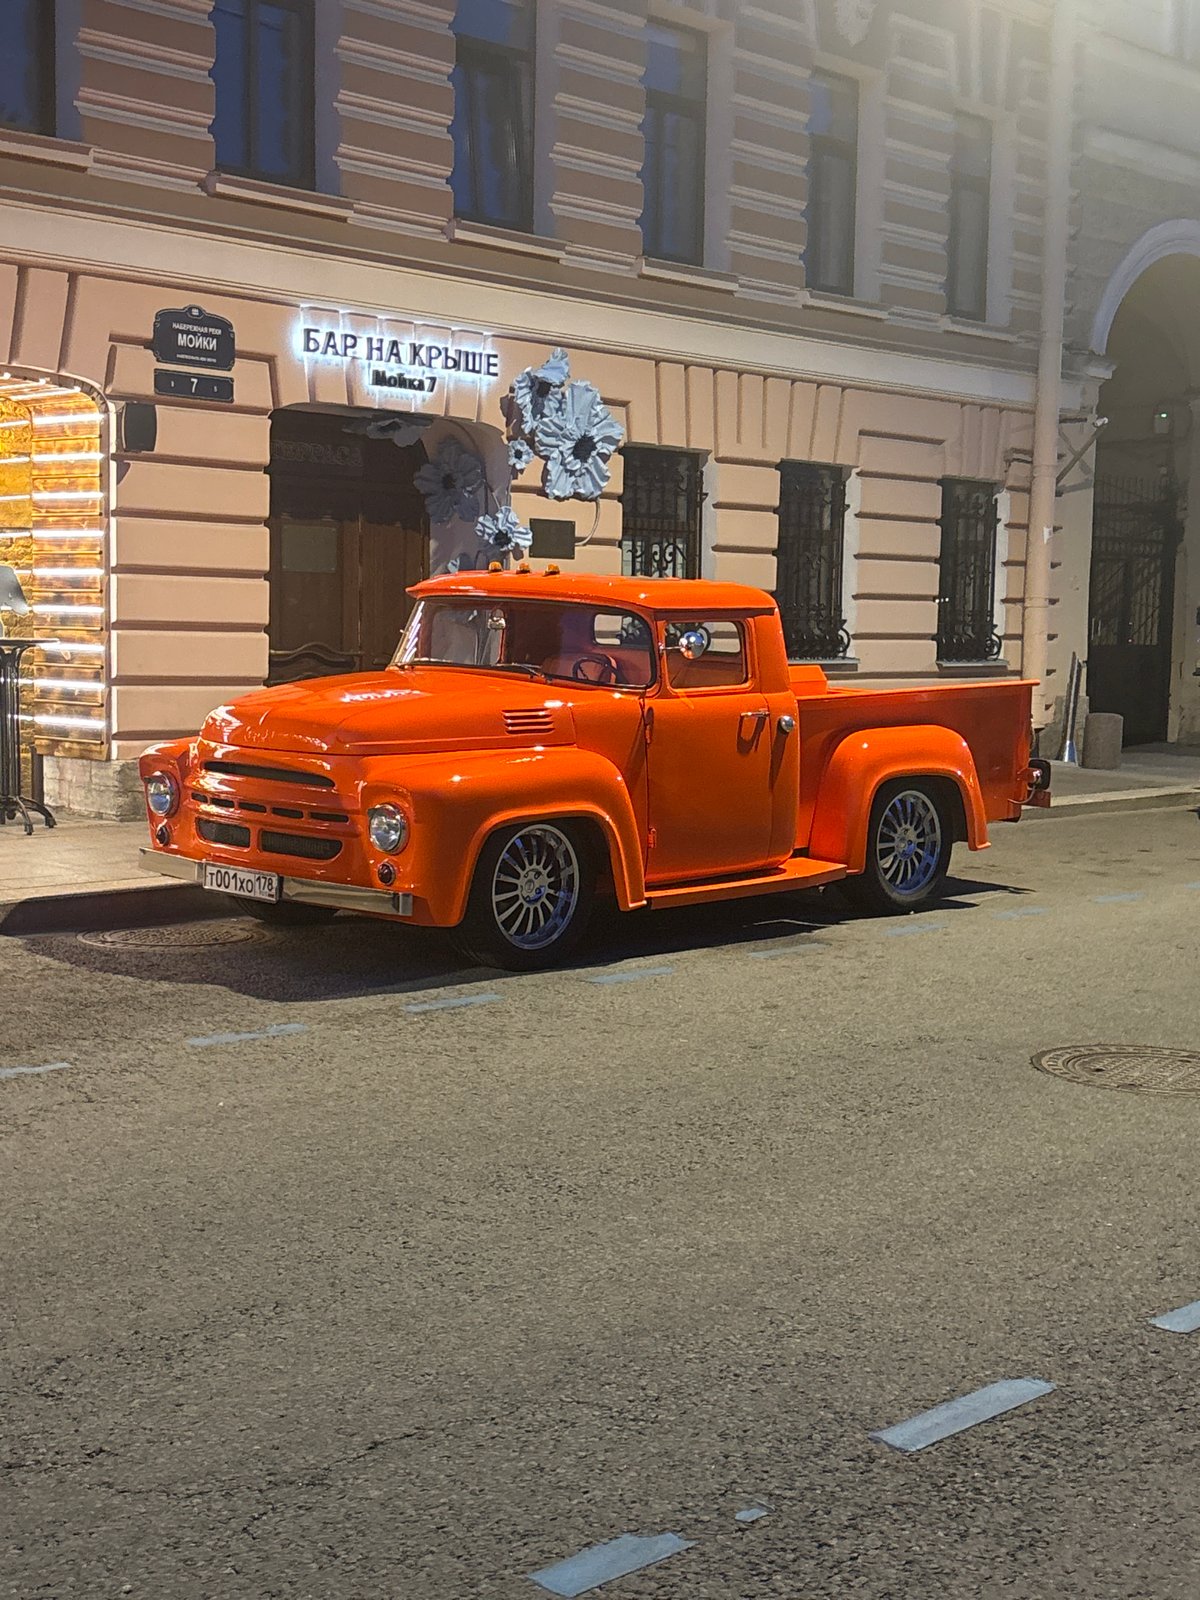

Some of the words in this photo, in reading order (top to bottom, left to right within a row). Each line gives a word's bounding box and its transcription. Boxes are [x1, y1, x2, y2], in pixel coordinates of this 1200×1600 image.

[177, 333, 217, 351] МОЙКИ
[303, 328, 358, 357] БАР
[366, 336, 403, 365] НА
[409, 342, 499, 377] КРЫШЕ
[190, 377, 198, 393] 7
[371, 369, 424, 391] Мойка
[424, 376, 438, 393] 7
[256, 876, 274, 891] 178
